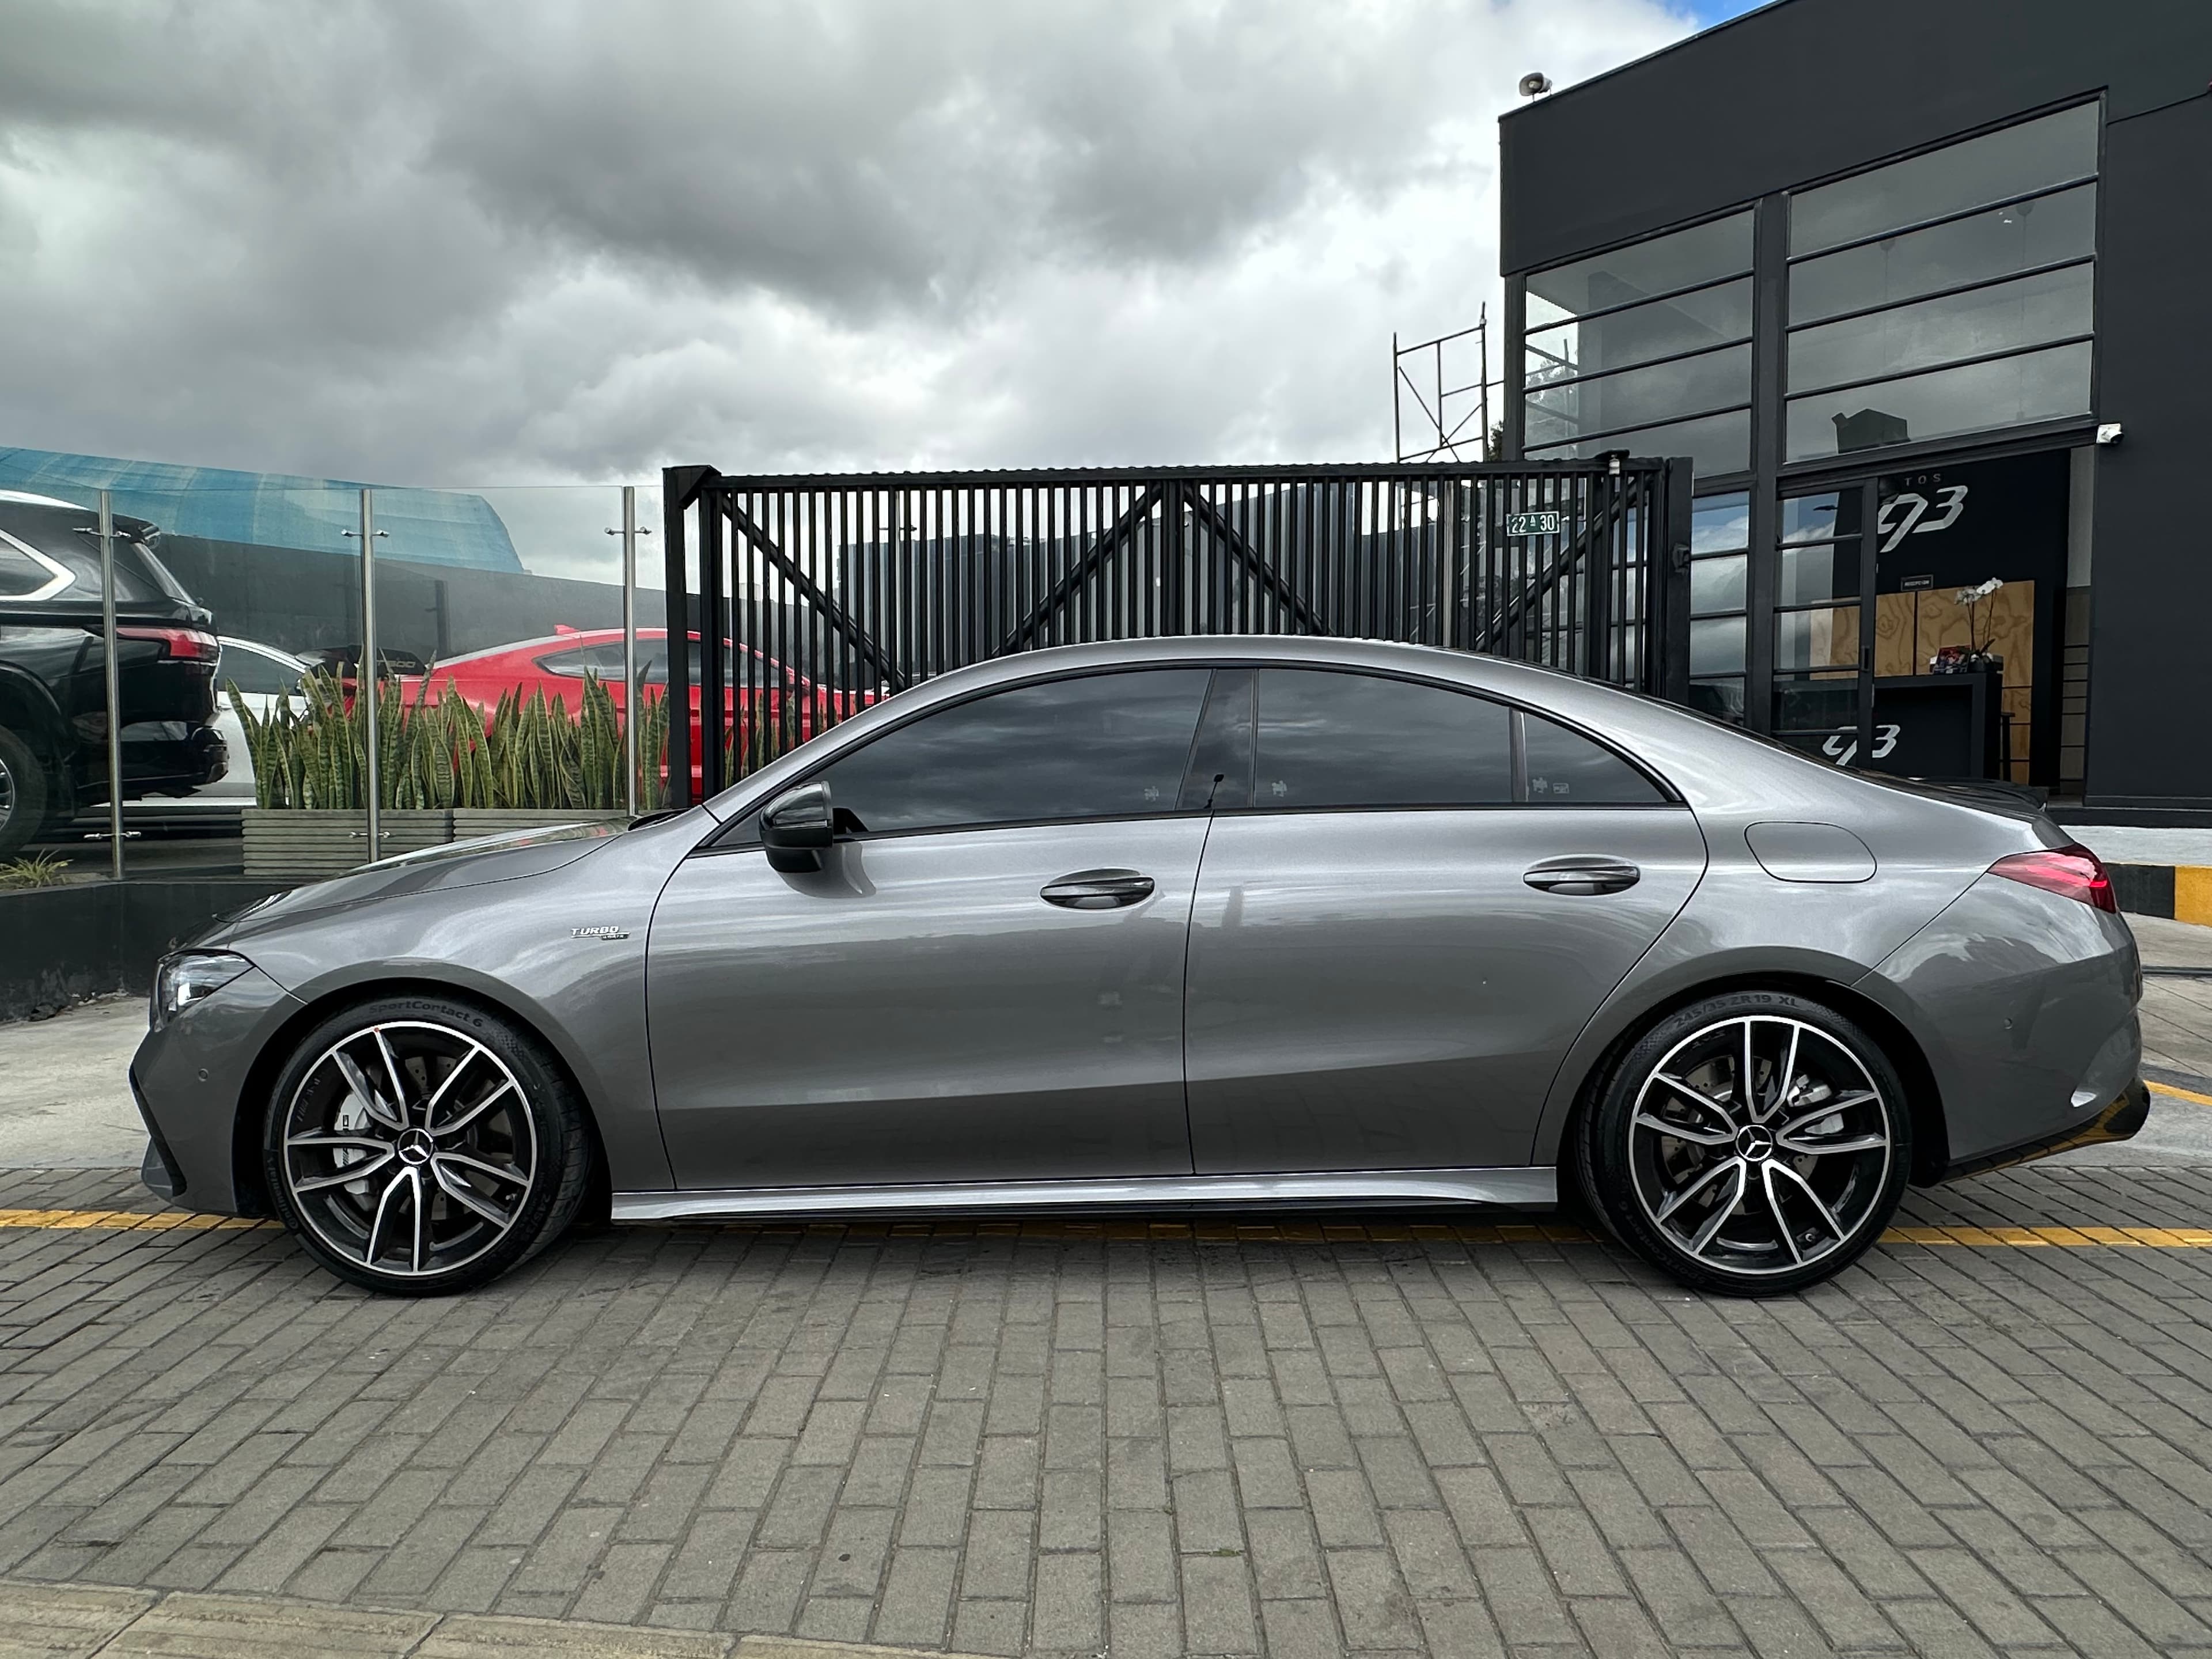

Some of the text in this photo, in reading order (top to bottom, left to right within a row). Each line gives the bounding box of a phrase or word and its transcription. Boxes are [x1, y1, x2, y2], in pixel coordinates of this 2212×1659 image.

[1511, 516, 1527, 533] 22
[1540, 514, 1555, 531] 30
[1877, 485, 1968, 553] 93
[571, 926, 619, 935] TURBO
[369, 1000, 483, 1028] SportContact 6
[1675, 999, 1727, 1028] 245/35
[1778, 995, 1798, 1007] XL
